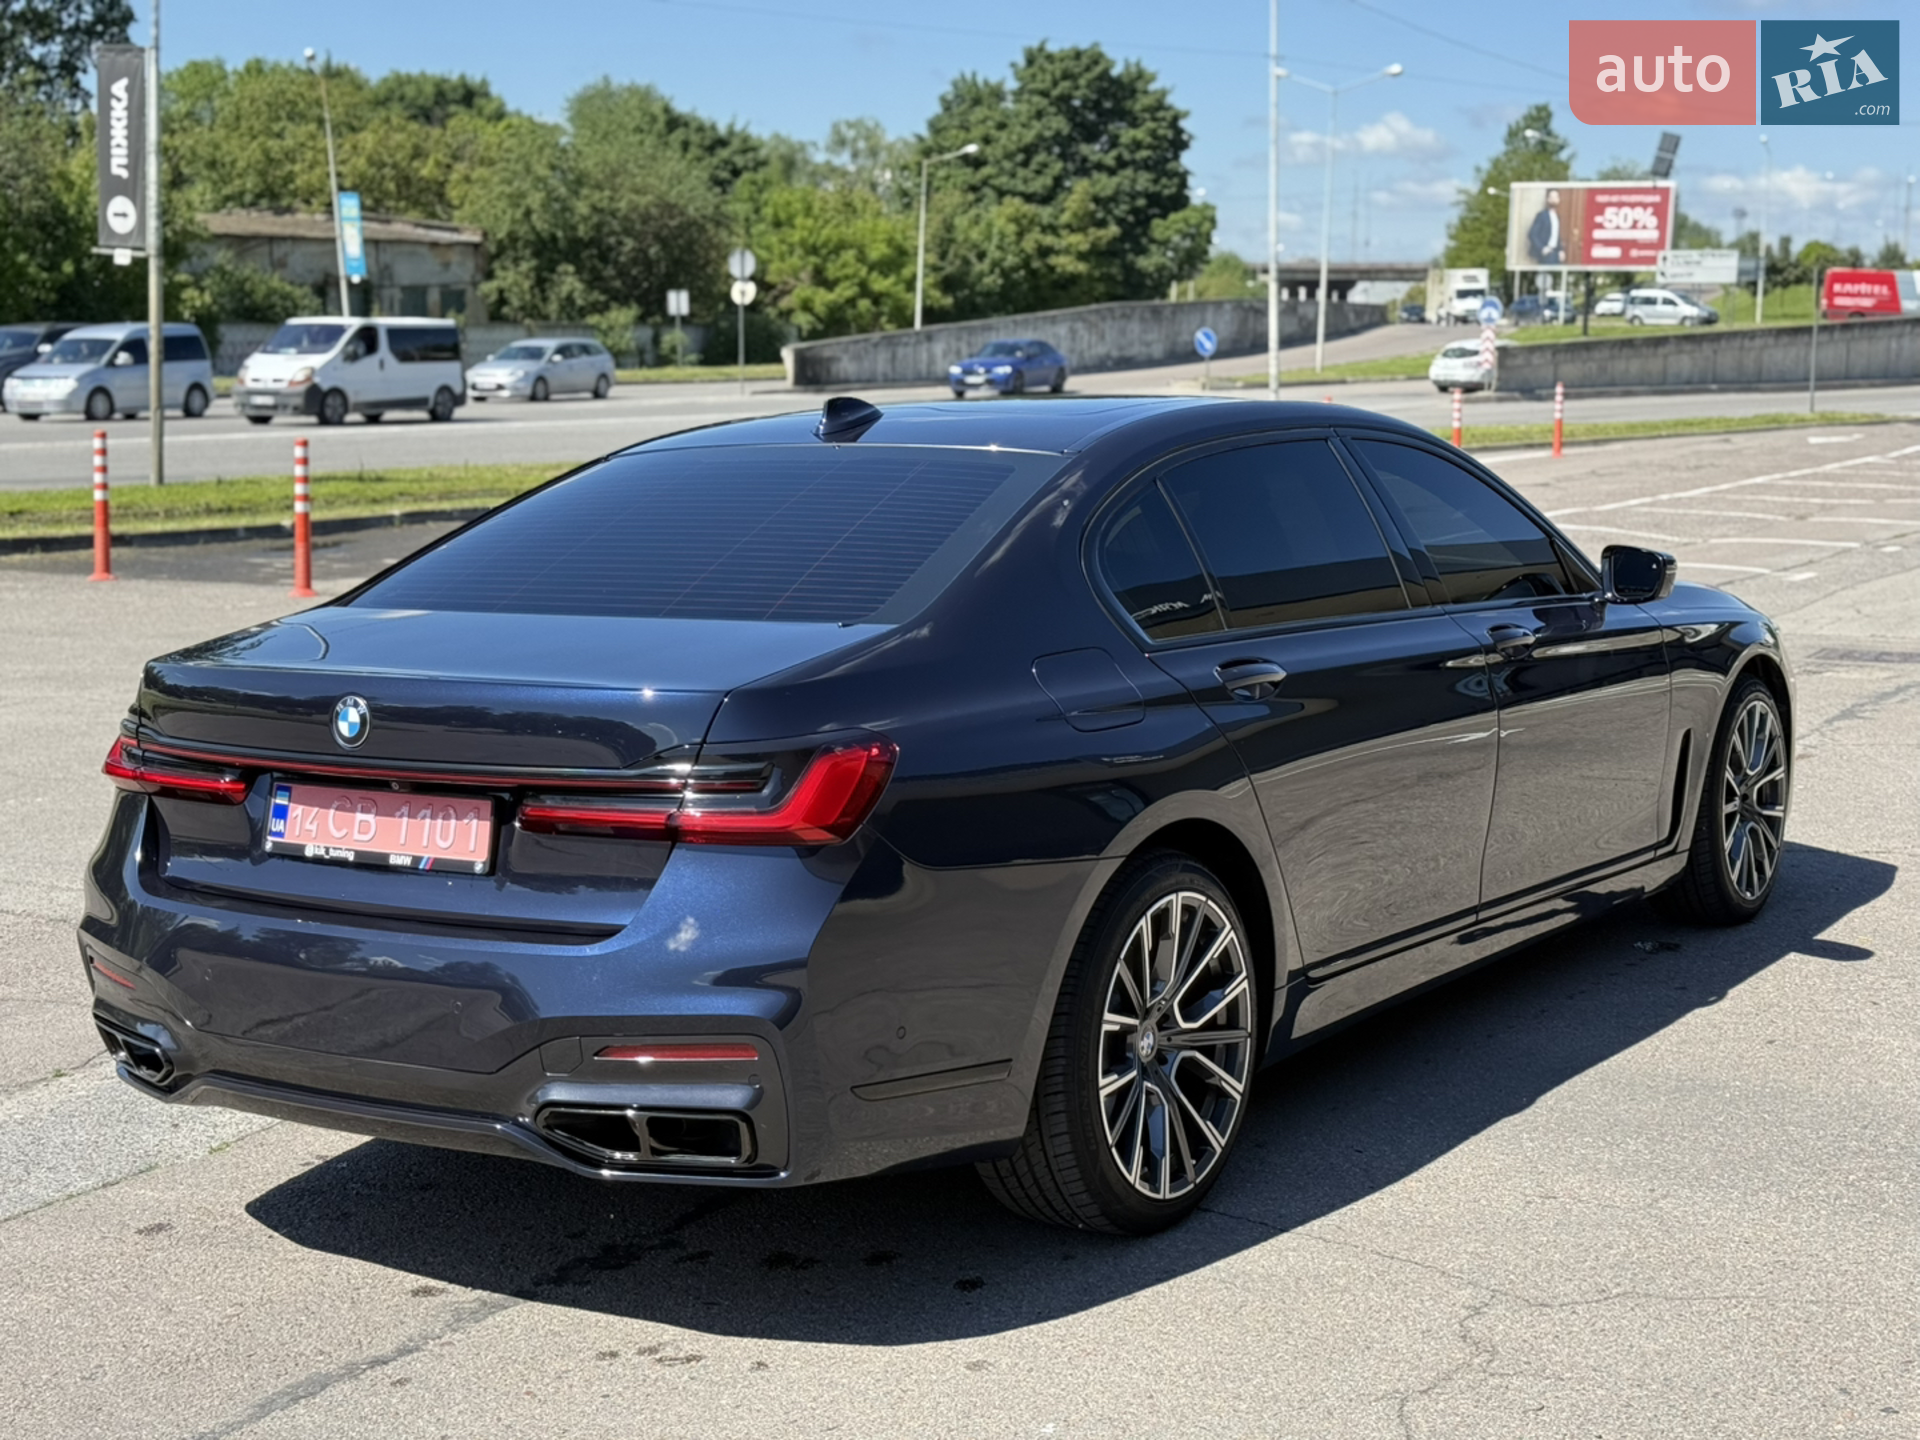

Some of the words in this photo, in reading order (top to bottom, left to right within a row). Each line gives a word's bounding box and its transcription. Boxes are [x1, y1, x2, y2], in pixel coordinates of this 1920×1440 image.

[110, 76, 129, 180] ЛІЖКА
[1593, 206, 1659, 229] -50%
[271, 818, 285, 833] UA
[394, 801, 480, 851] 1101
[388, 854, 413, 866] BMW
